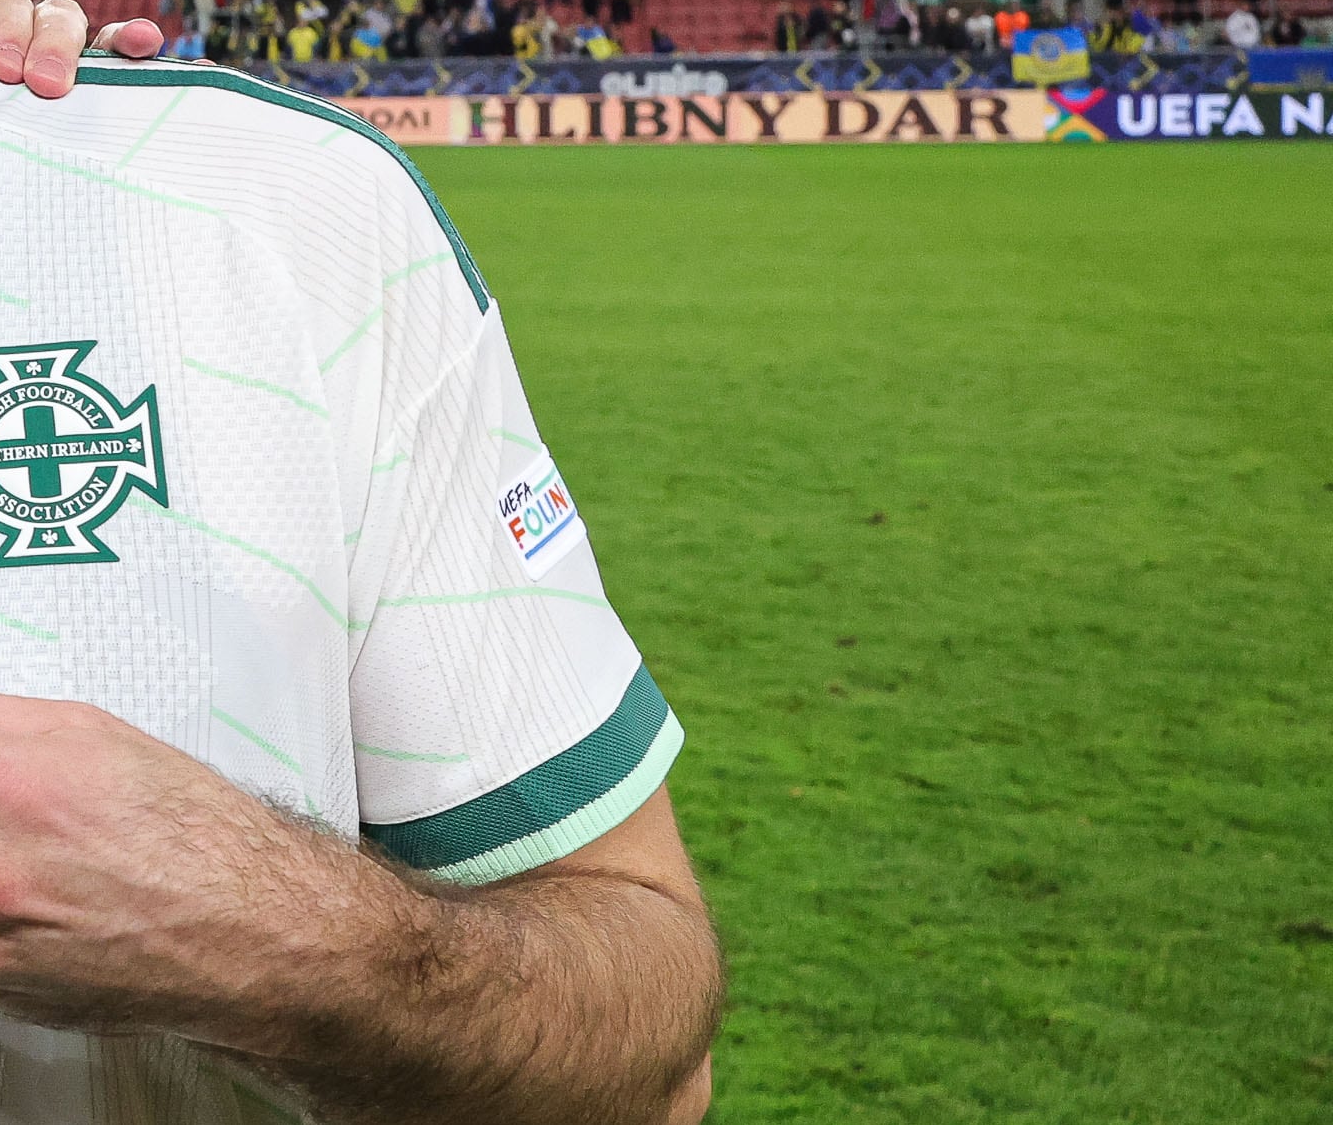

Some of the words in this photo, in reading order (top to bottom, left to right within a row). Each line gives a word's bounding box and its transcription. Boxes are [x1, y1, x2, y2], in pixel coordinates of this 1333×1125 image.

[469, 97, 793, 138] HLIBNY
[823, 95, 1010, 137] DAR
[1116, 92, 1265, 137] UEFA
[1280, 91, 1333, 137] N
[15, 385, 103, 428] FOOTBALL
[51, 439, 124, 458] IRELAND
[498, 481, 533, 518] UEFA
